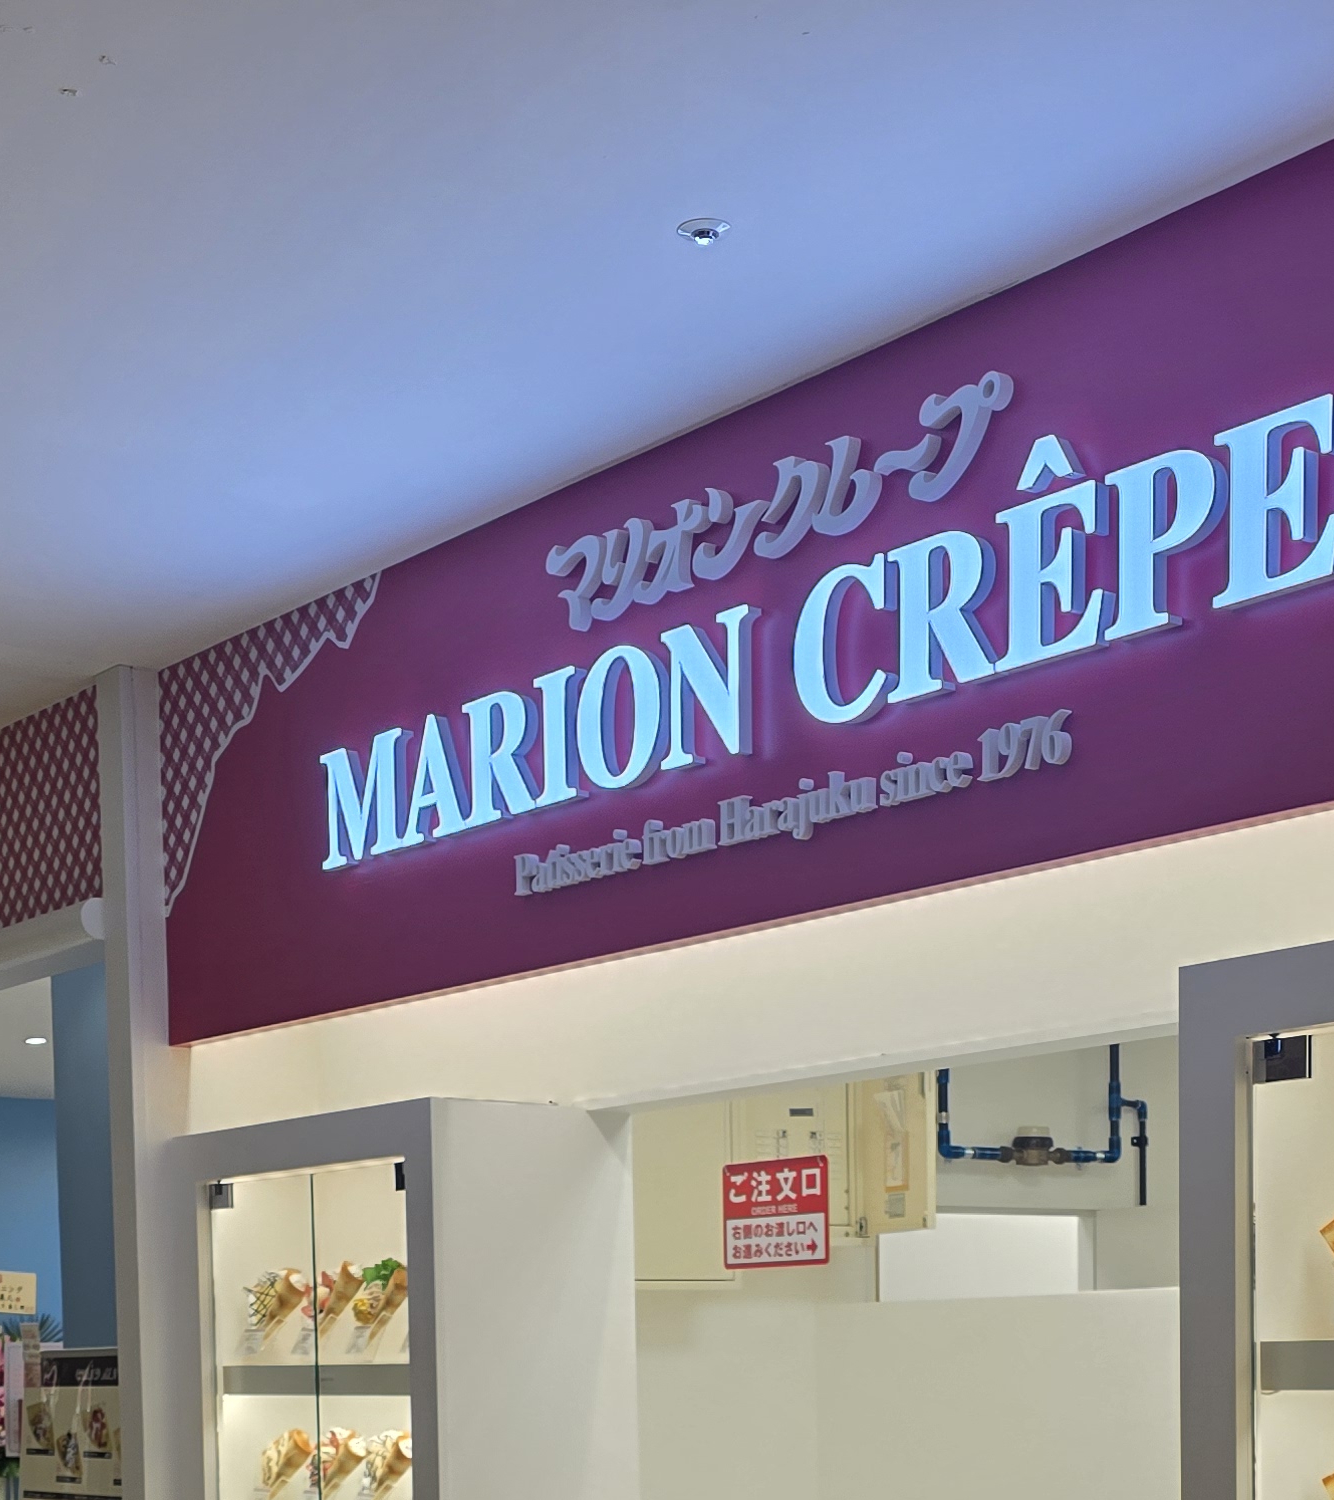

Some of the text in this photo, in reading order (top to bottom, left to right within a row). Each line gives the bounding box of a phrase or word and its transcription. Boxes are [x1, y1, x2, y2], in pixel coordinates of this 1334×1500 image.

[547, 370, 1015, 632] マリオンクレープ
[321, 604, 753, 871] MARION
[514, 709, 1073, 896] Patisserie from Harajuku since 1976
[727, 1166, 822, 1204] ご注文口
[751, 1203, 799, 1216] ORDER HERE
[731, 1221, 818, 1240] 右側のお渡し口へ
[731, 1241, 807, 1260] お進みください
